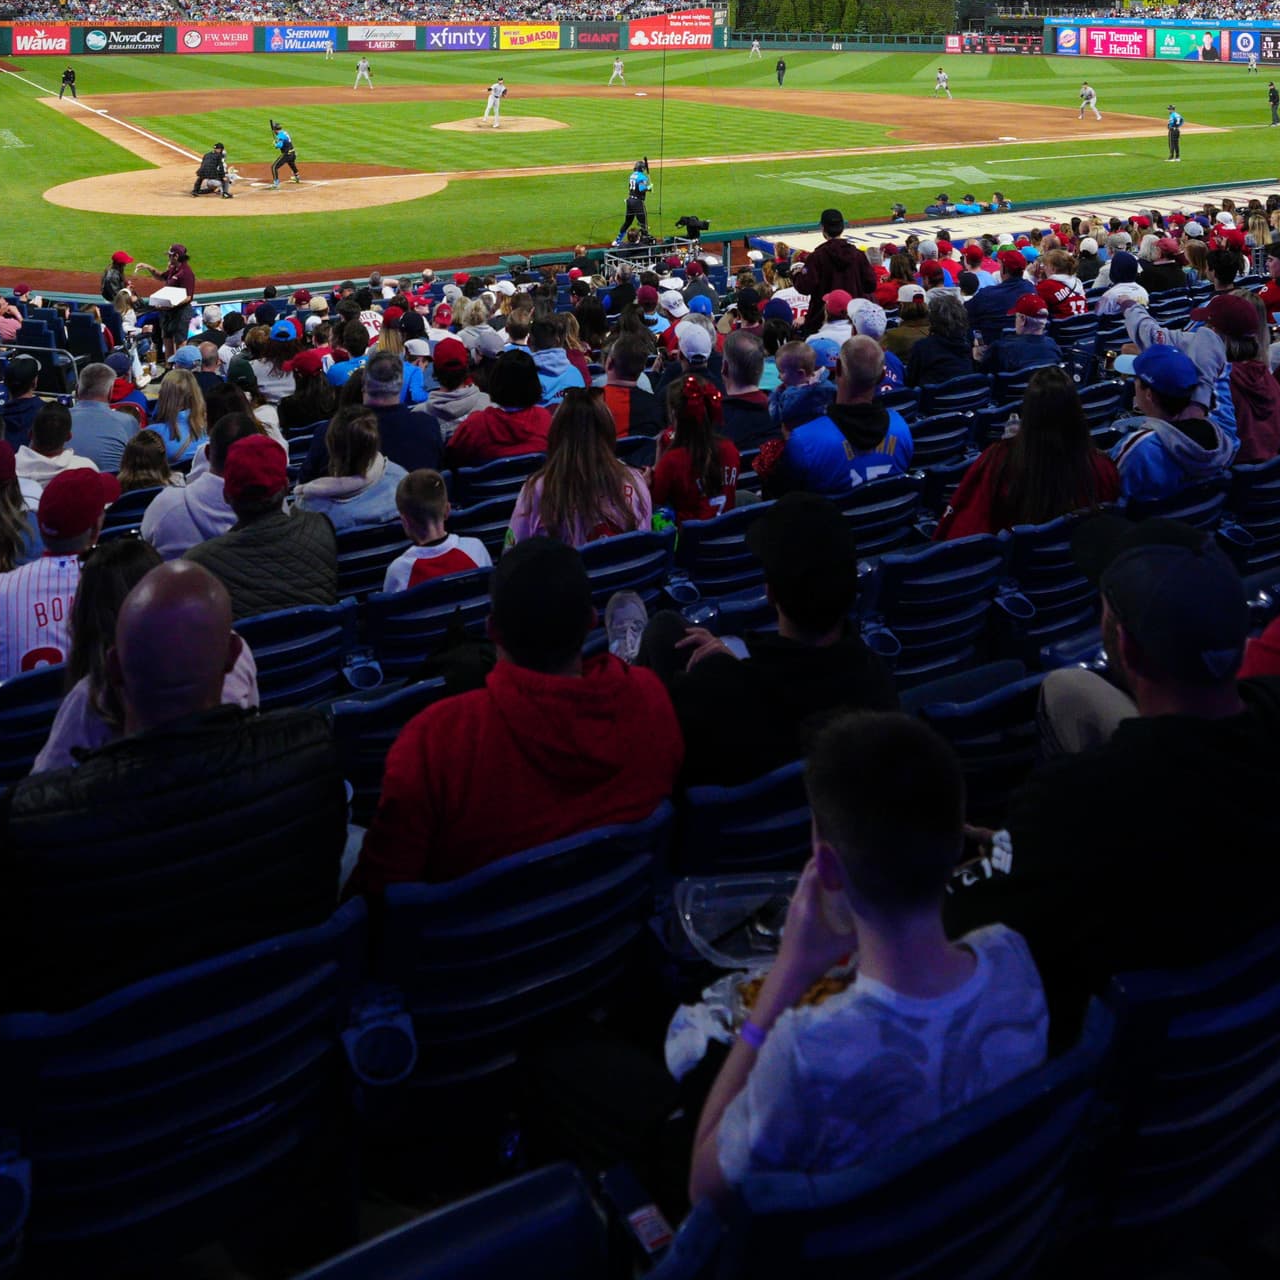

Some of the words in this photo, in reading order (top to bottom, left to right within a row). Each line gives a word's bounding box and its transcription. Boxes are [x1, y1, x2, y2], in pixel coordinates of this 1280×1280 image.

[108, 31, 162, 43] NovaCare
[222, 33, 248, 41] WEBB
[285, 29, 330, 39] SHERWIN
[430, 30, 487, 47] xfinity
[578, 33, 619, 44] GIANT
[1108, 31, 1142, 43] Temple
[15, 35, 68, 51] Wawa
[284, 39, 330, 50] WILLIAMS
[368, 41, 396, 49] LAGER
[831, 42, 842, 51] 401
[1109, 44, 1141, 55] Health
